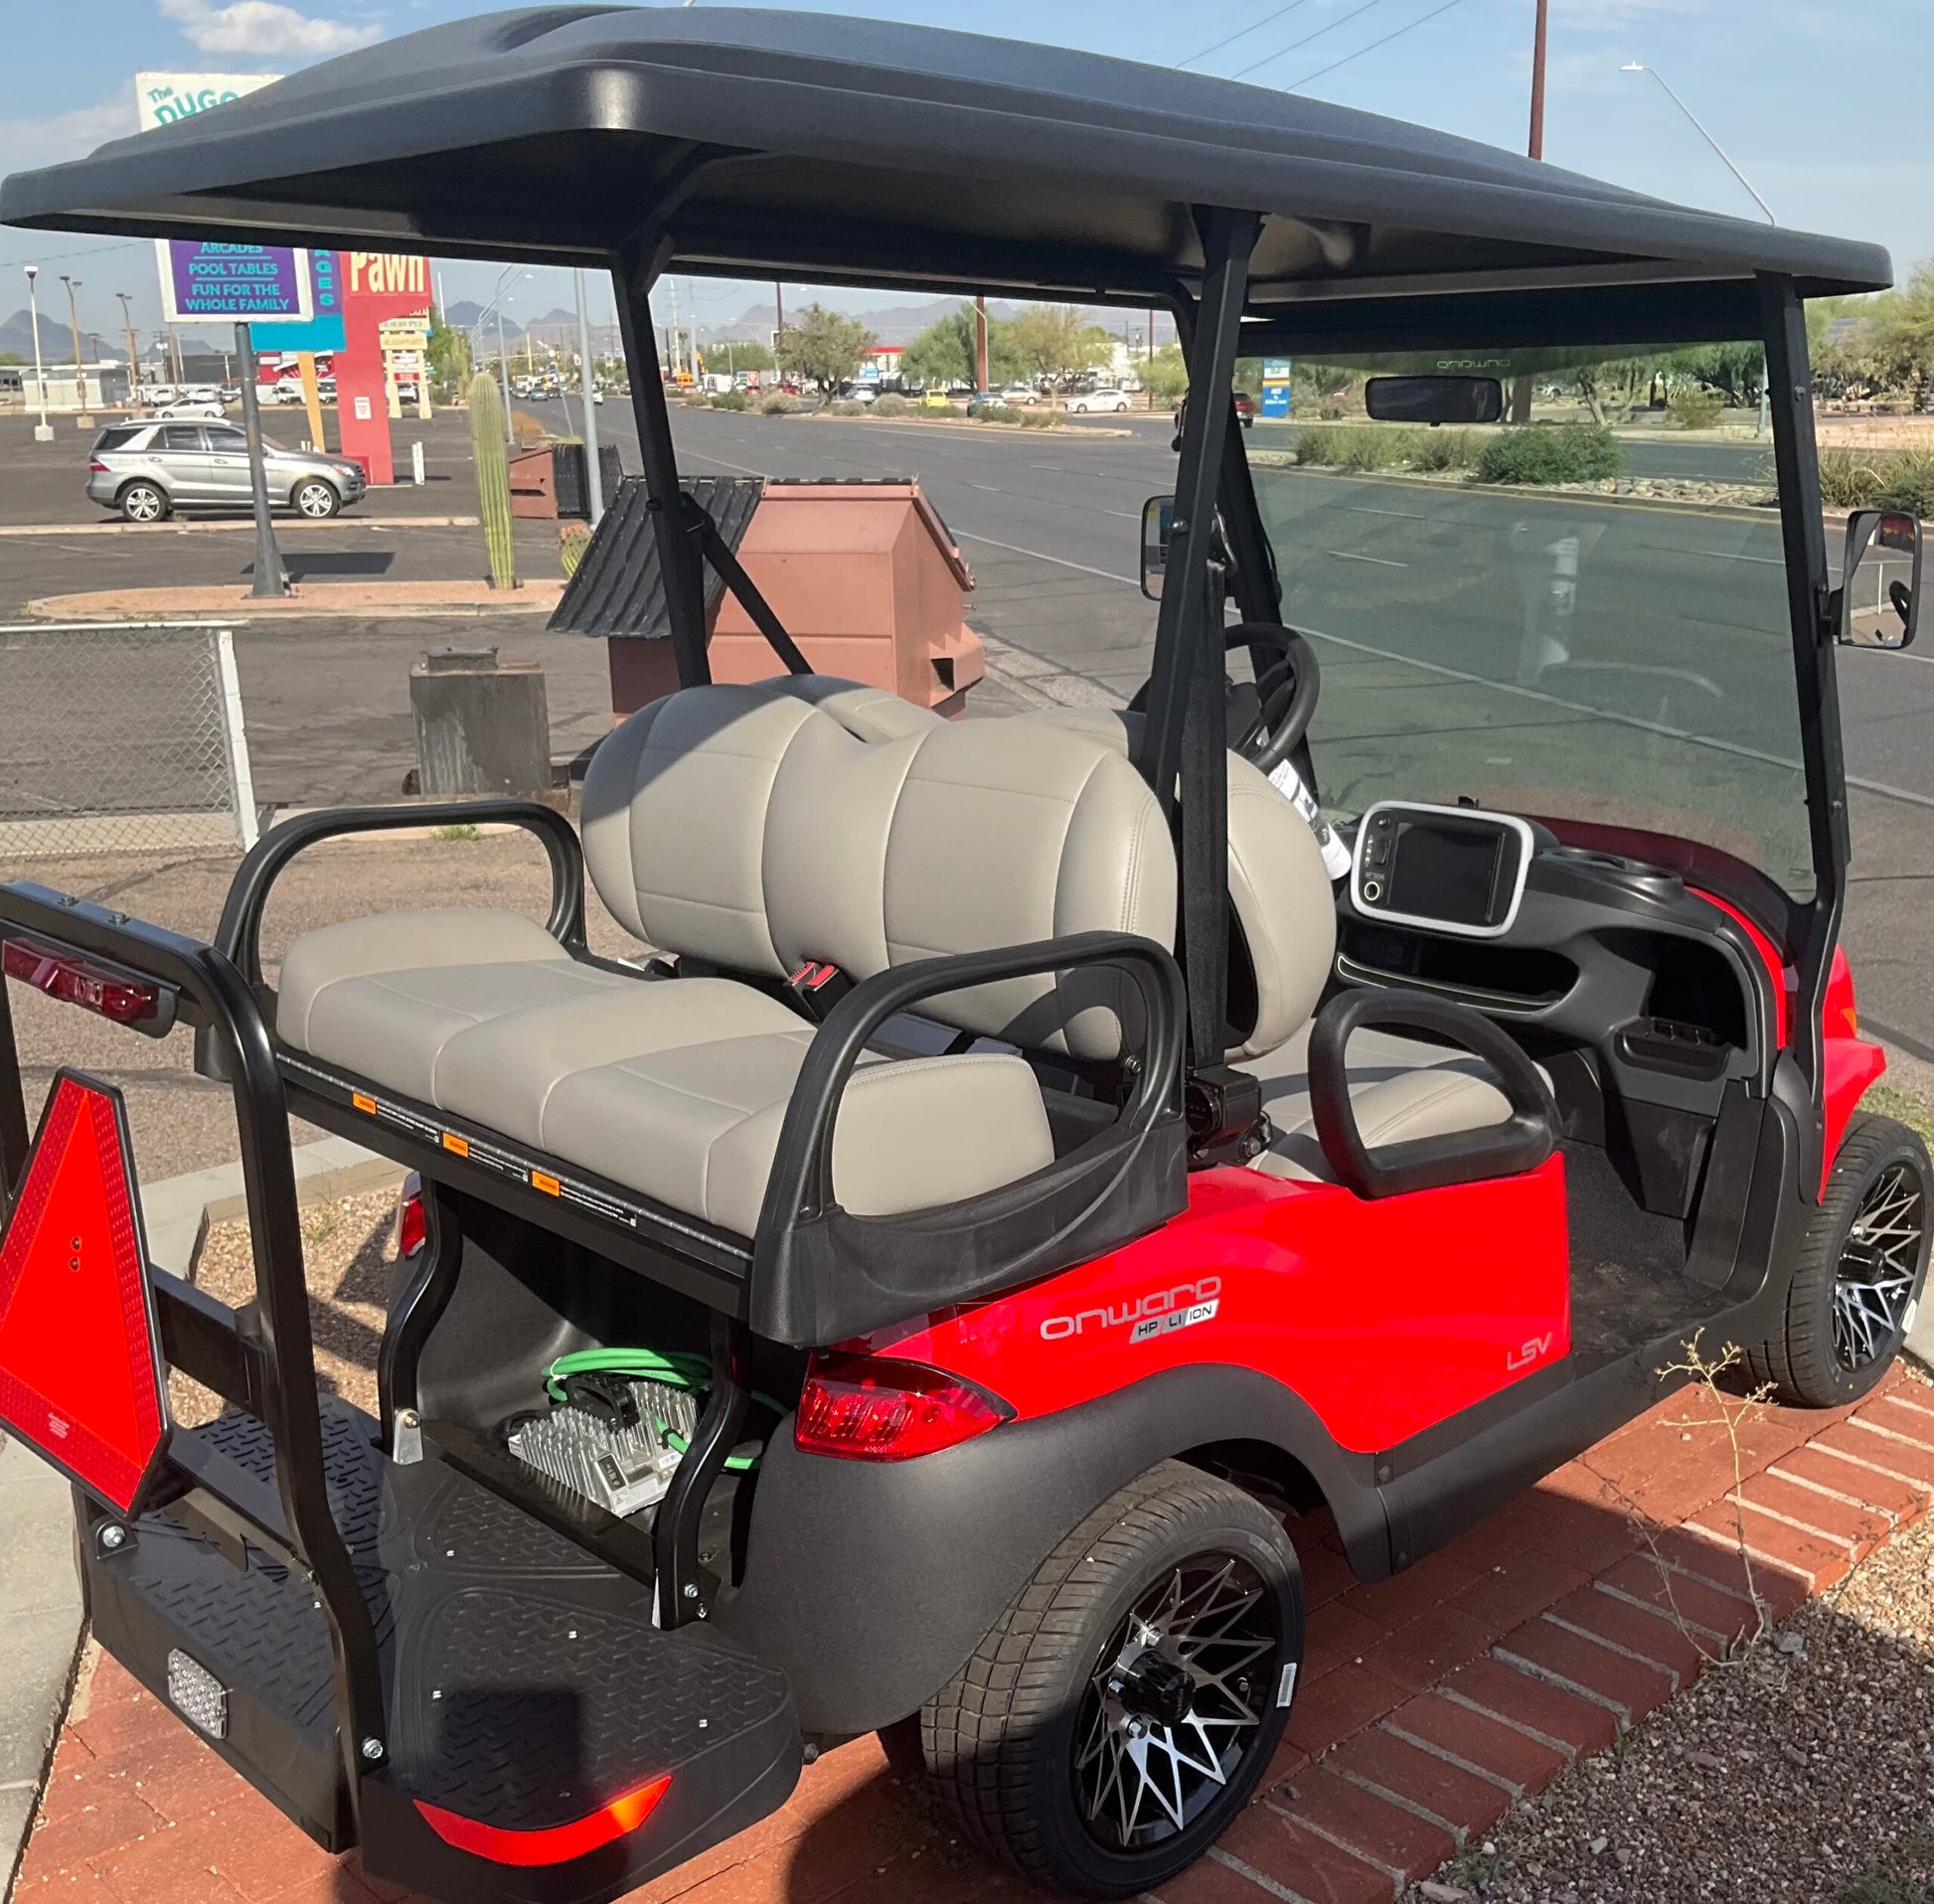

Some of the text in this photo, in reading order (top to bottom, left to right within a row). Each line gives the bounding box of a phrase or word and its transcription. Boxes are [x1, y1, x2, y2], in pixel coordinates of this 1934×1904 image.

[201, 242, 263, 253] ARCADES
[189, 263, 278, 275] POOL TABLES
[350, 251, 424, 292] Pawn
[192, 284, 280, 295] FUN FOR THE
[185, 299, 289, 310] WHOLE FAMILY
[1138, 1321, 1159, 1336] HP
[1189, 1304, 1212, 1321] ION
[1507, 1332, 1552, 1371] LSV
